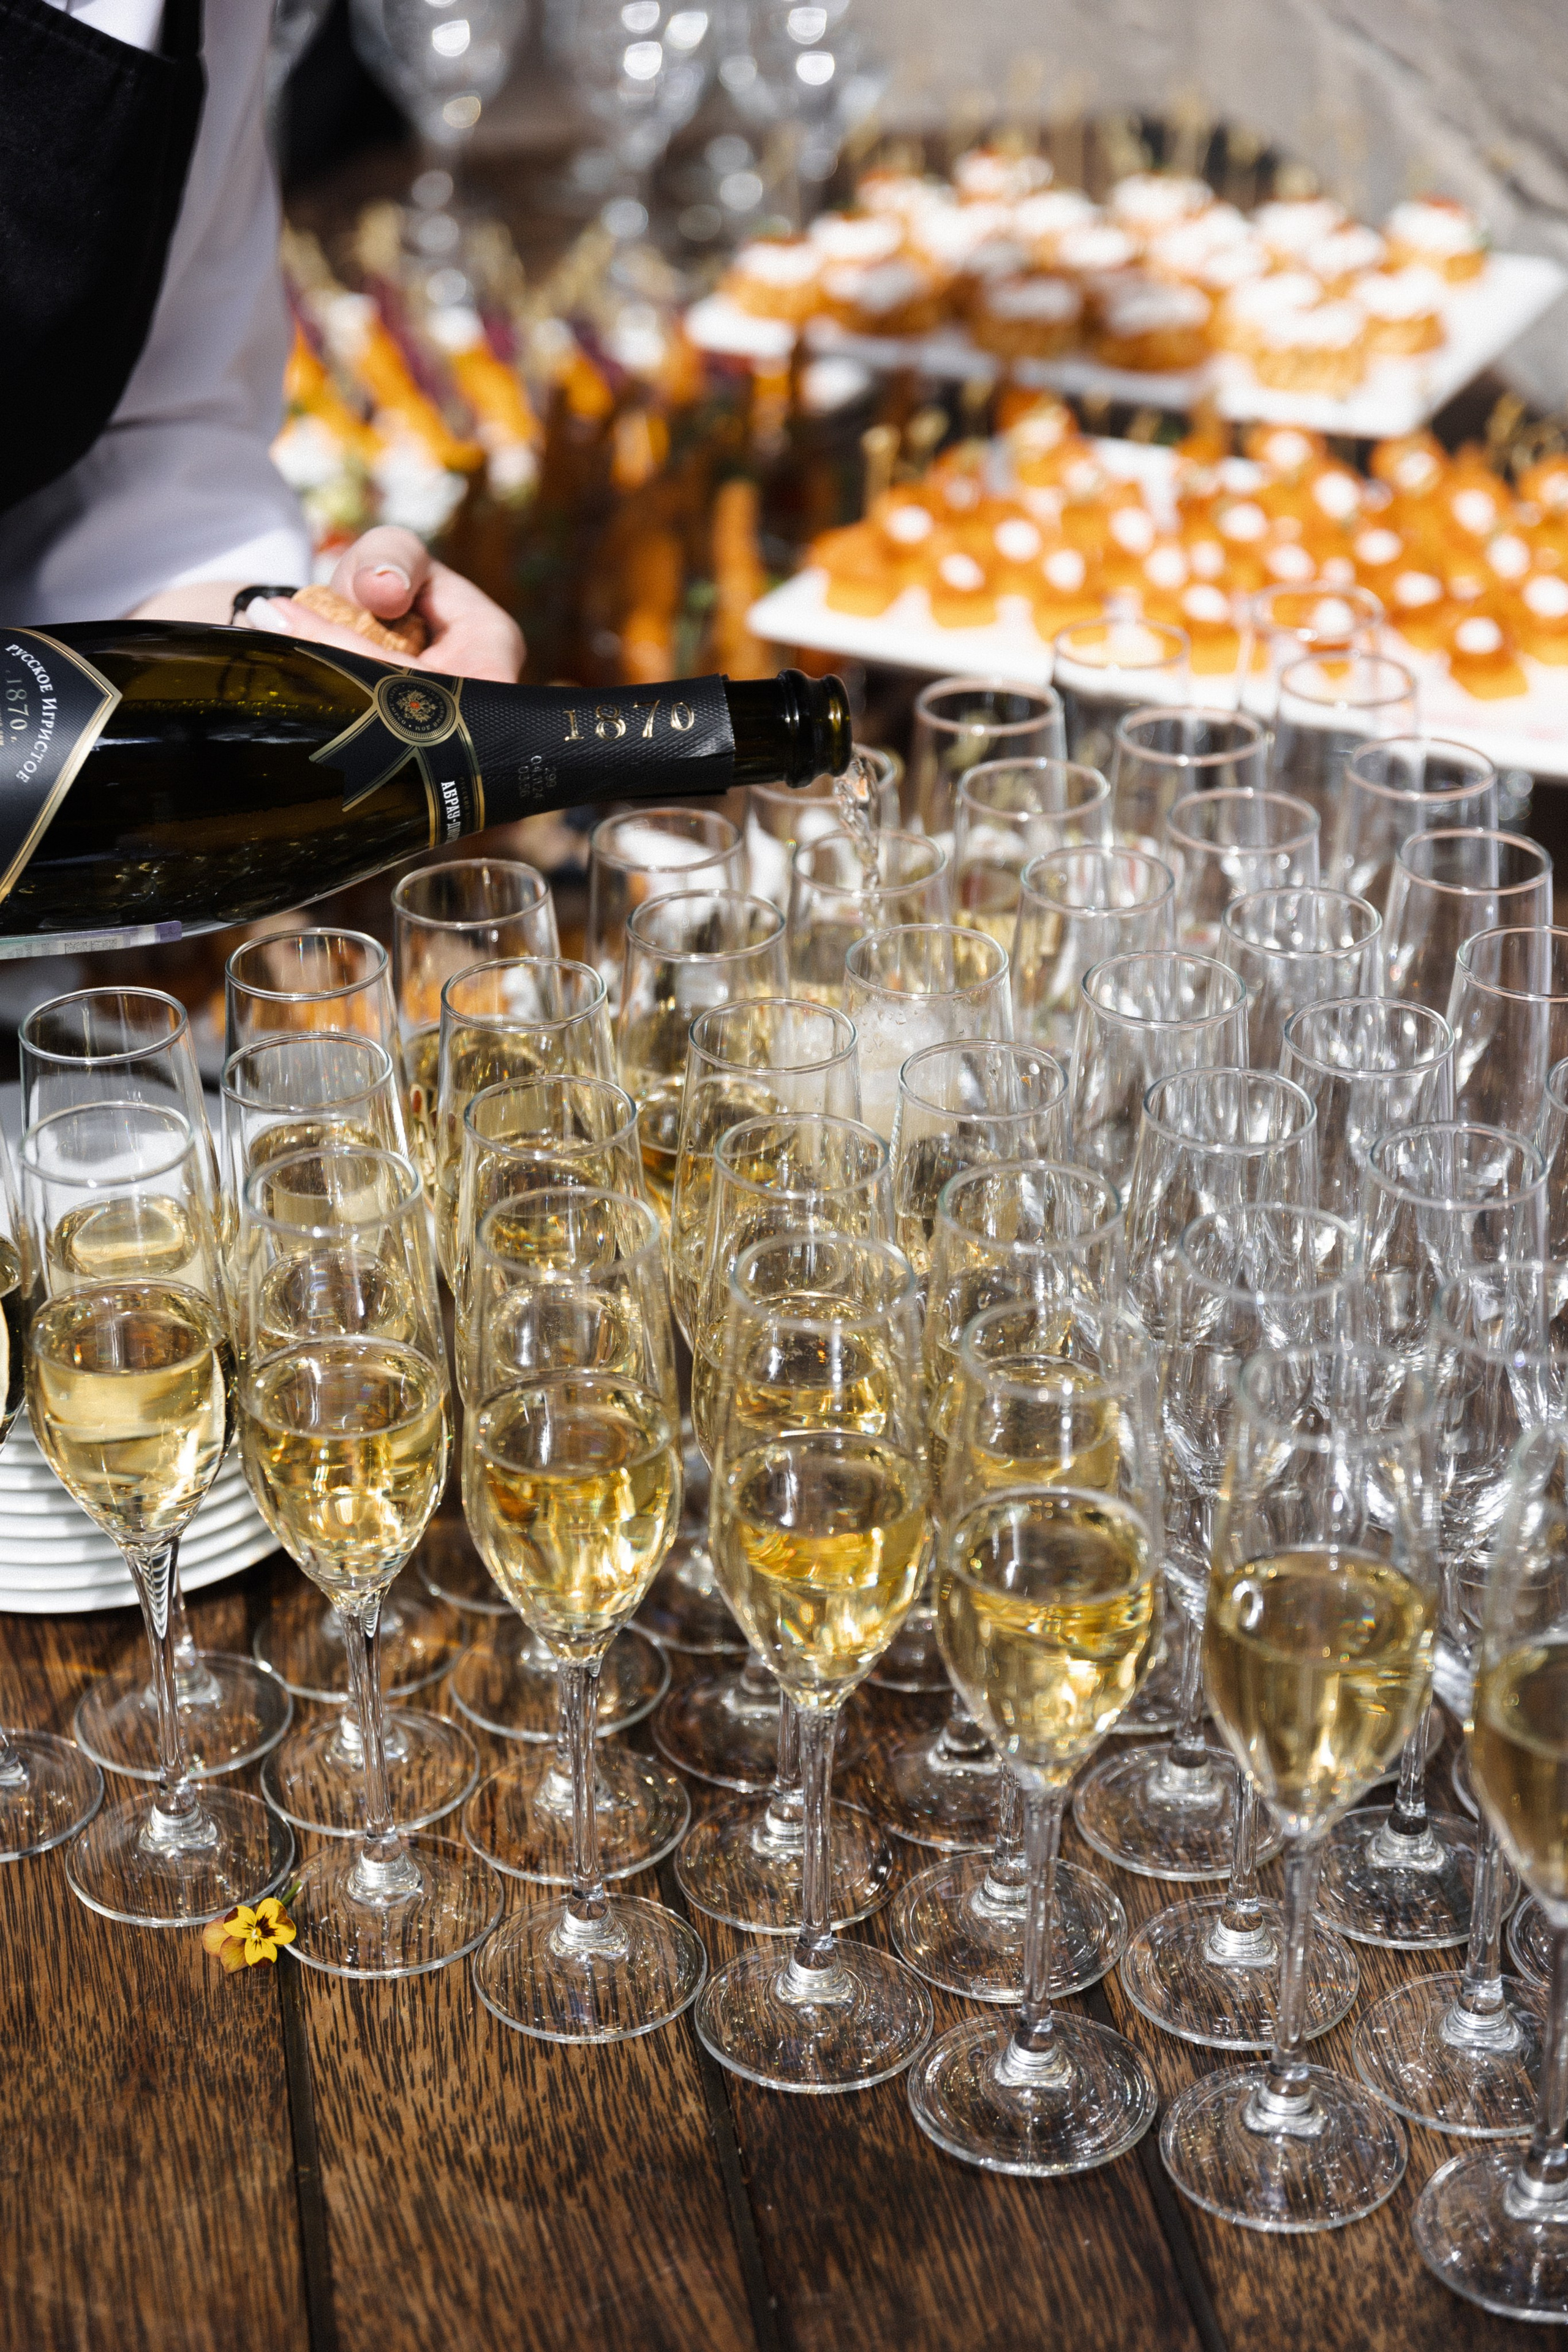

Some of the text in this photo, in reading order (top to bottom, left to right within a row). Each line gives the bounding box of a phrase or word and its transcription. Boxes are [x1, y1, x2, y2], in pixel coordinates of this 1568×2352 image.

[5, 678, 29, 731] 1870
[5, 644, 58, 783] РУССКОЕ ИГРИСТОЕ
[562, 699, 695, 742] 1870
